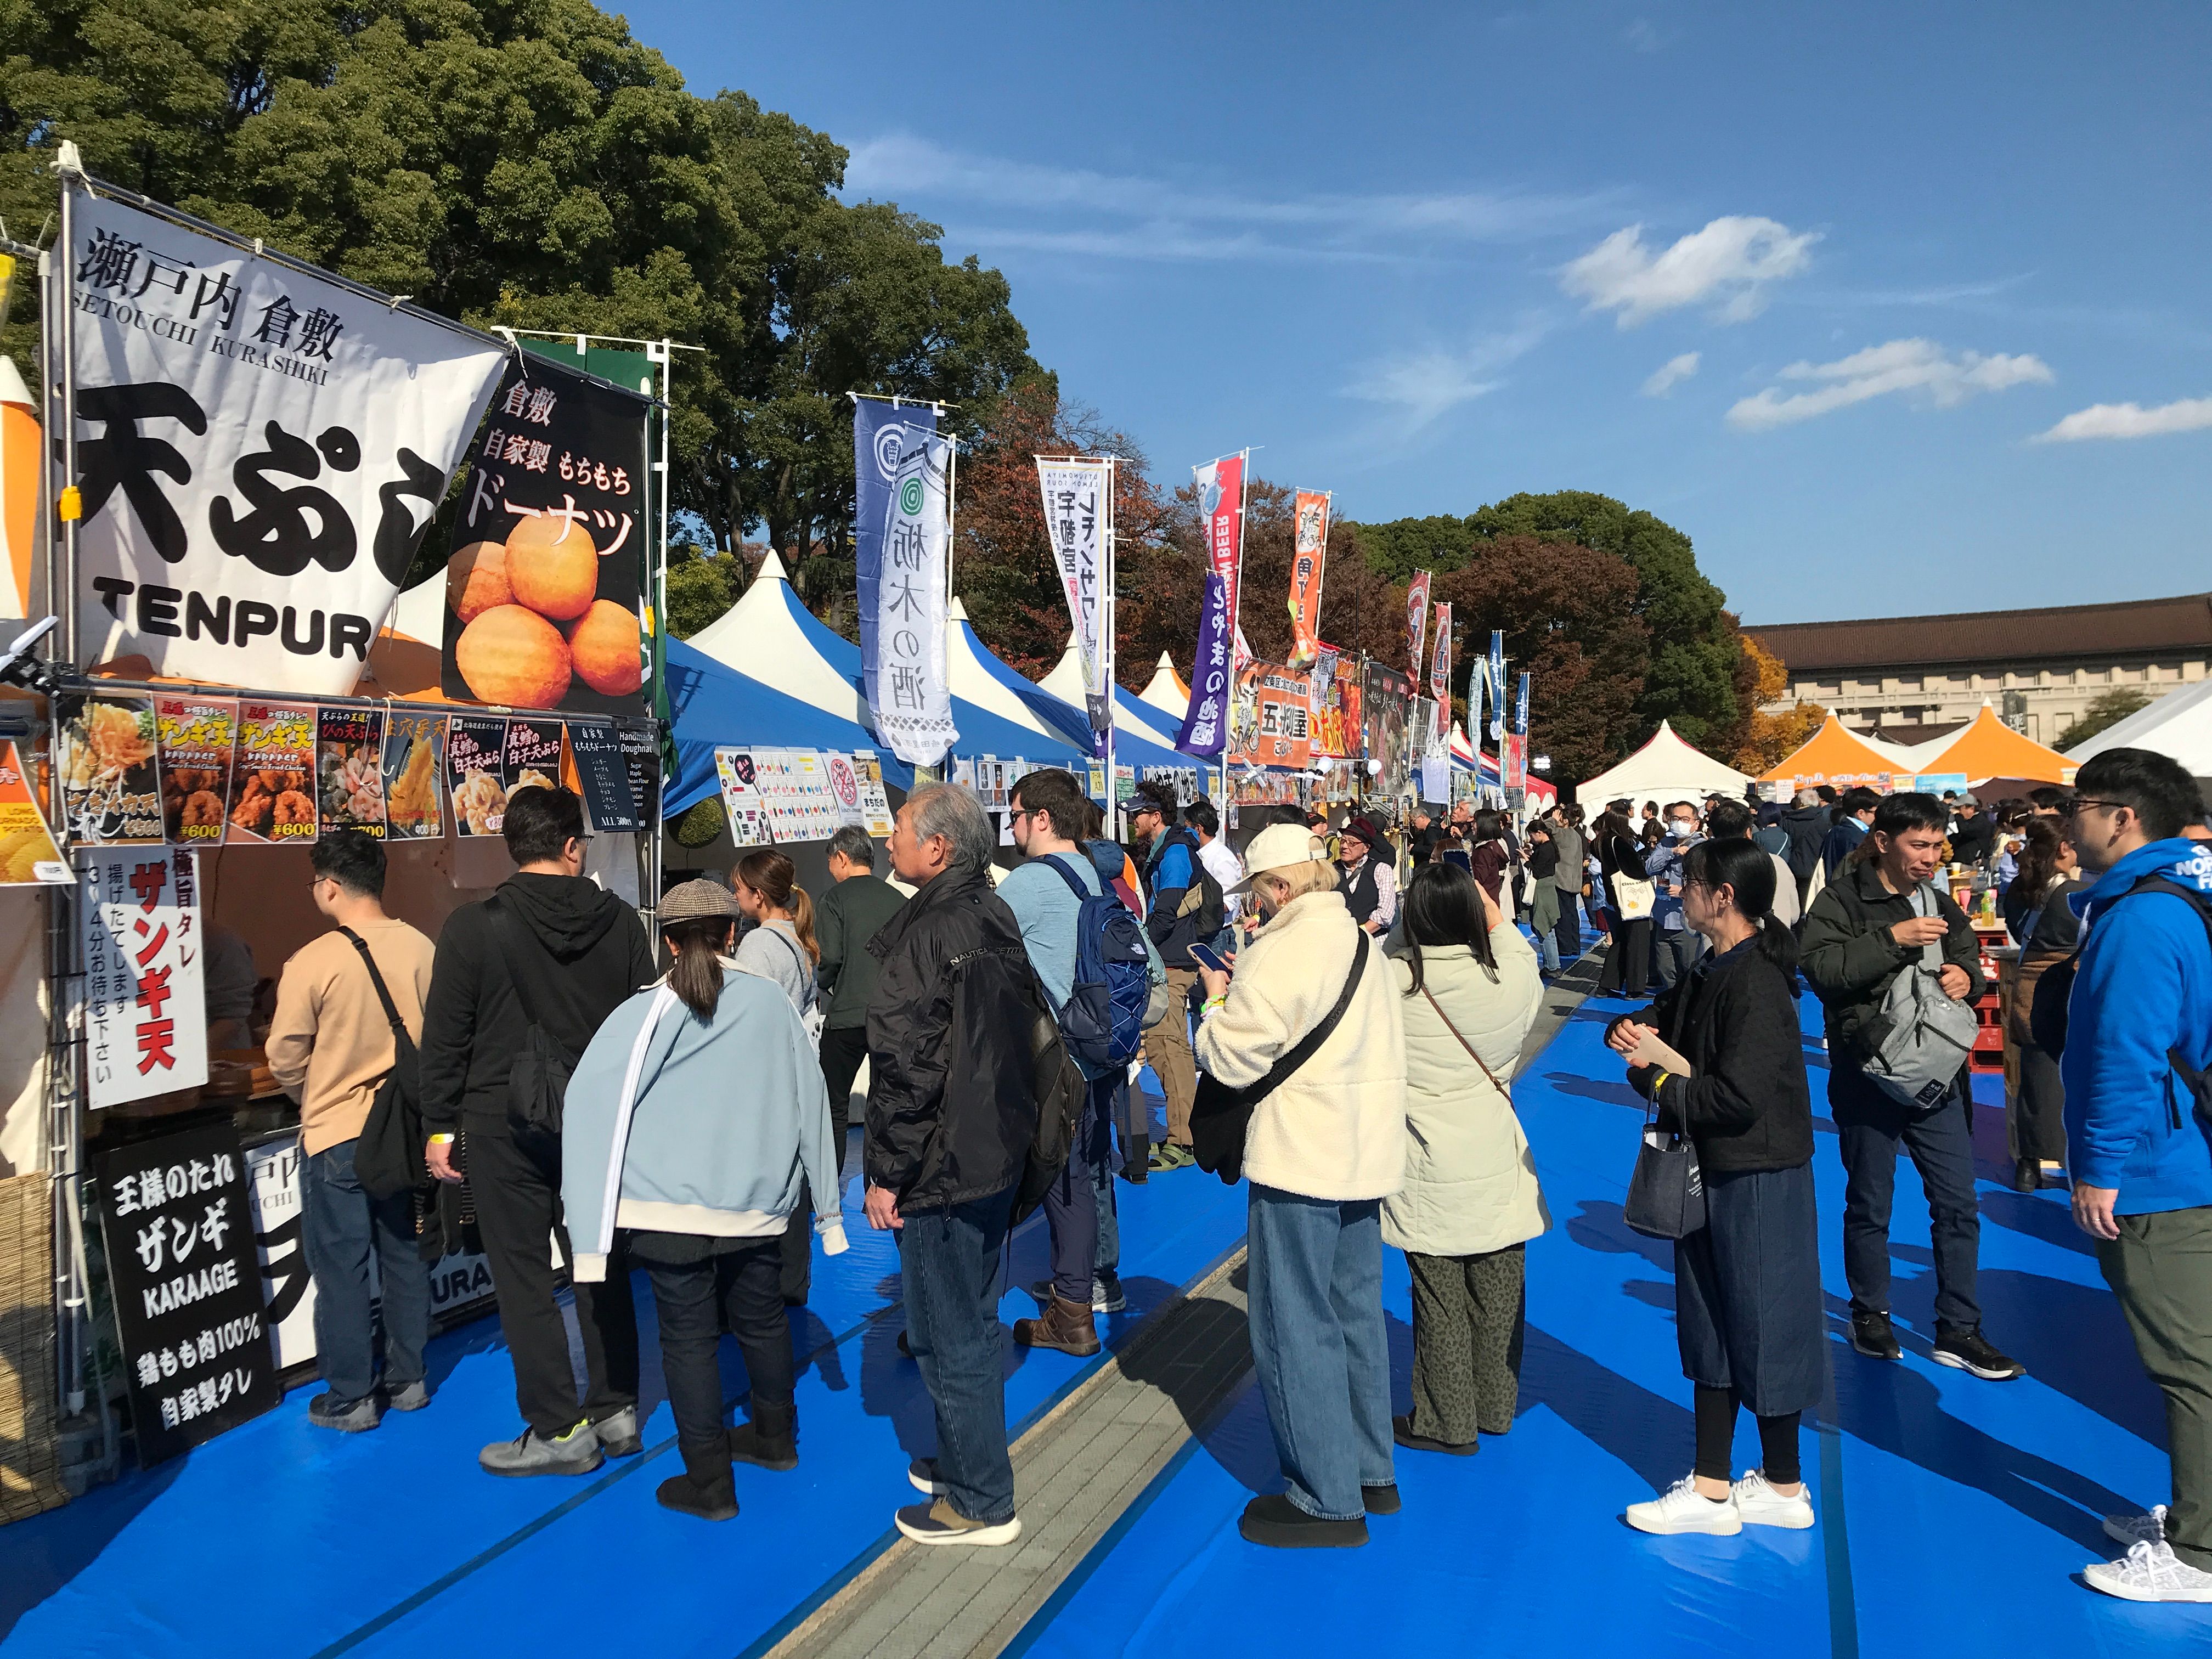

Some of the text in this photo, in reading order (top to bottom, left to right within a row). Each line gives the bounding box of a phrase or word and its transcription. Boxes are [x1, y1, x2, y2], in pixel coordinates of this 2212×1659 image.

[77, 226, 344, 363] 瀬戸内 倉敷
[209, 336, 329, 387] KURASHIKI
[500, 378, 558, 427] 倉敷
[483, 428, 631, 495] 自家製 もちもち
[467, 467, 634, 556] ドーナツ
[237, 719, 315, 750] ザンギ天
[507, 728, 540, 749] 真鱈の
[575, 742, 617, 752] もちもちドーナツ
[582, 727, 605, 739] 自家製
[619, 731, 654, 742] Handmade
[165, 749, 216, 761] KARAAGE
[247, 752, 298, 763] KARAAGE
[454, 751, 500, 774] 白子天ぷら
[509, 741, 560, 765] 白子天ぷら
[864, 798, 885, 808] まちだの
[179, 824, 221, 838] ¥600
[273, 823, 315, 836] ¥600
[107, 863, 129, 1014] 揚げたてします
[129, 860, 176, 1076] ザンギ天
[112, 1153, 235, 1217] 王様のたれ
[136, 1197, 230, 1273] ザンギ
[142, 1258, 239, 1319] KARAAGE
[161, 1367, 251, 1431] 自家製タレ
